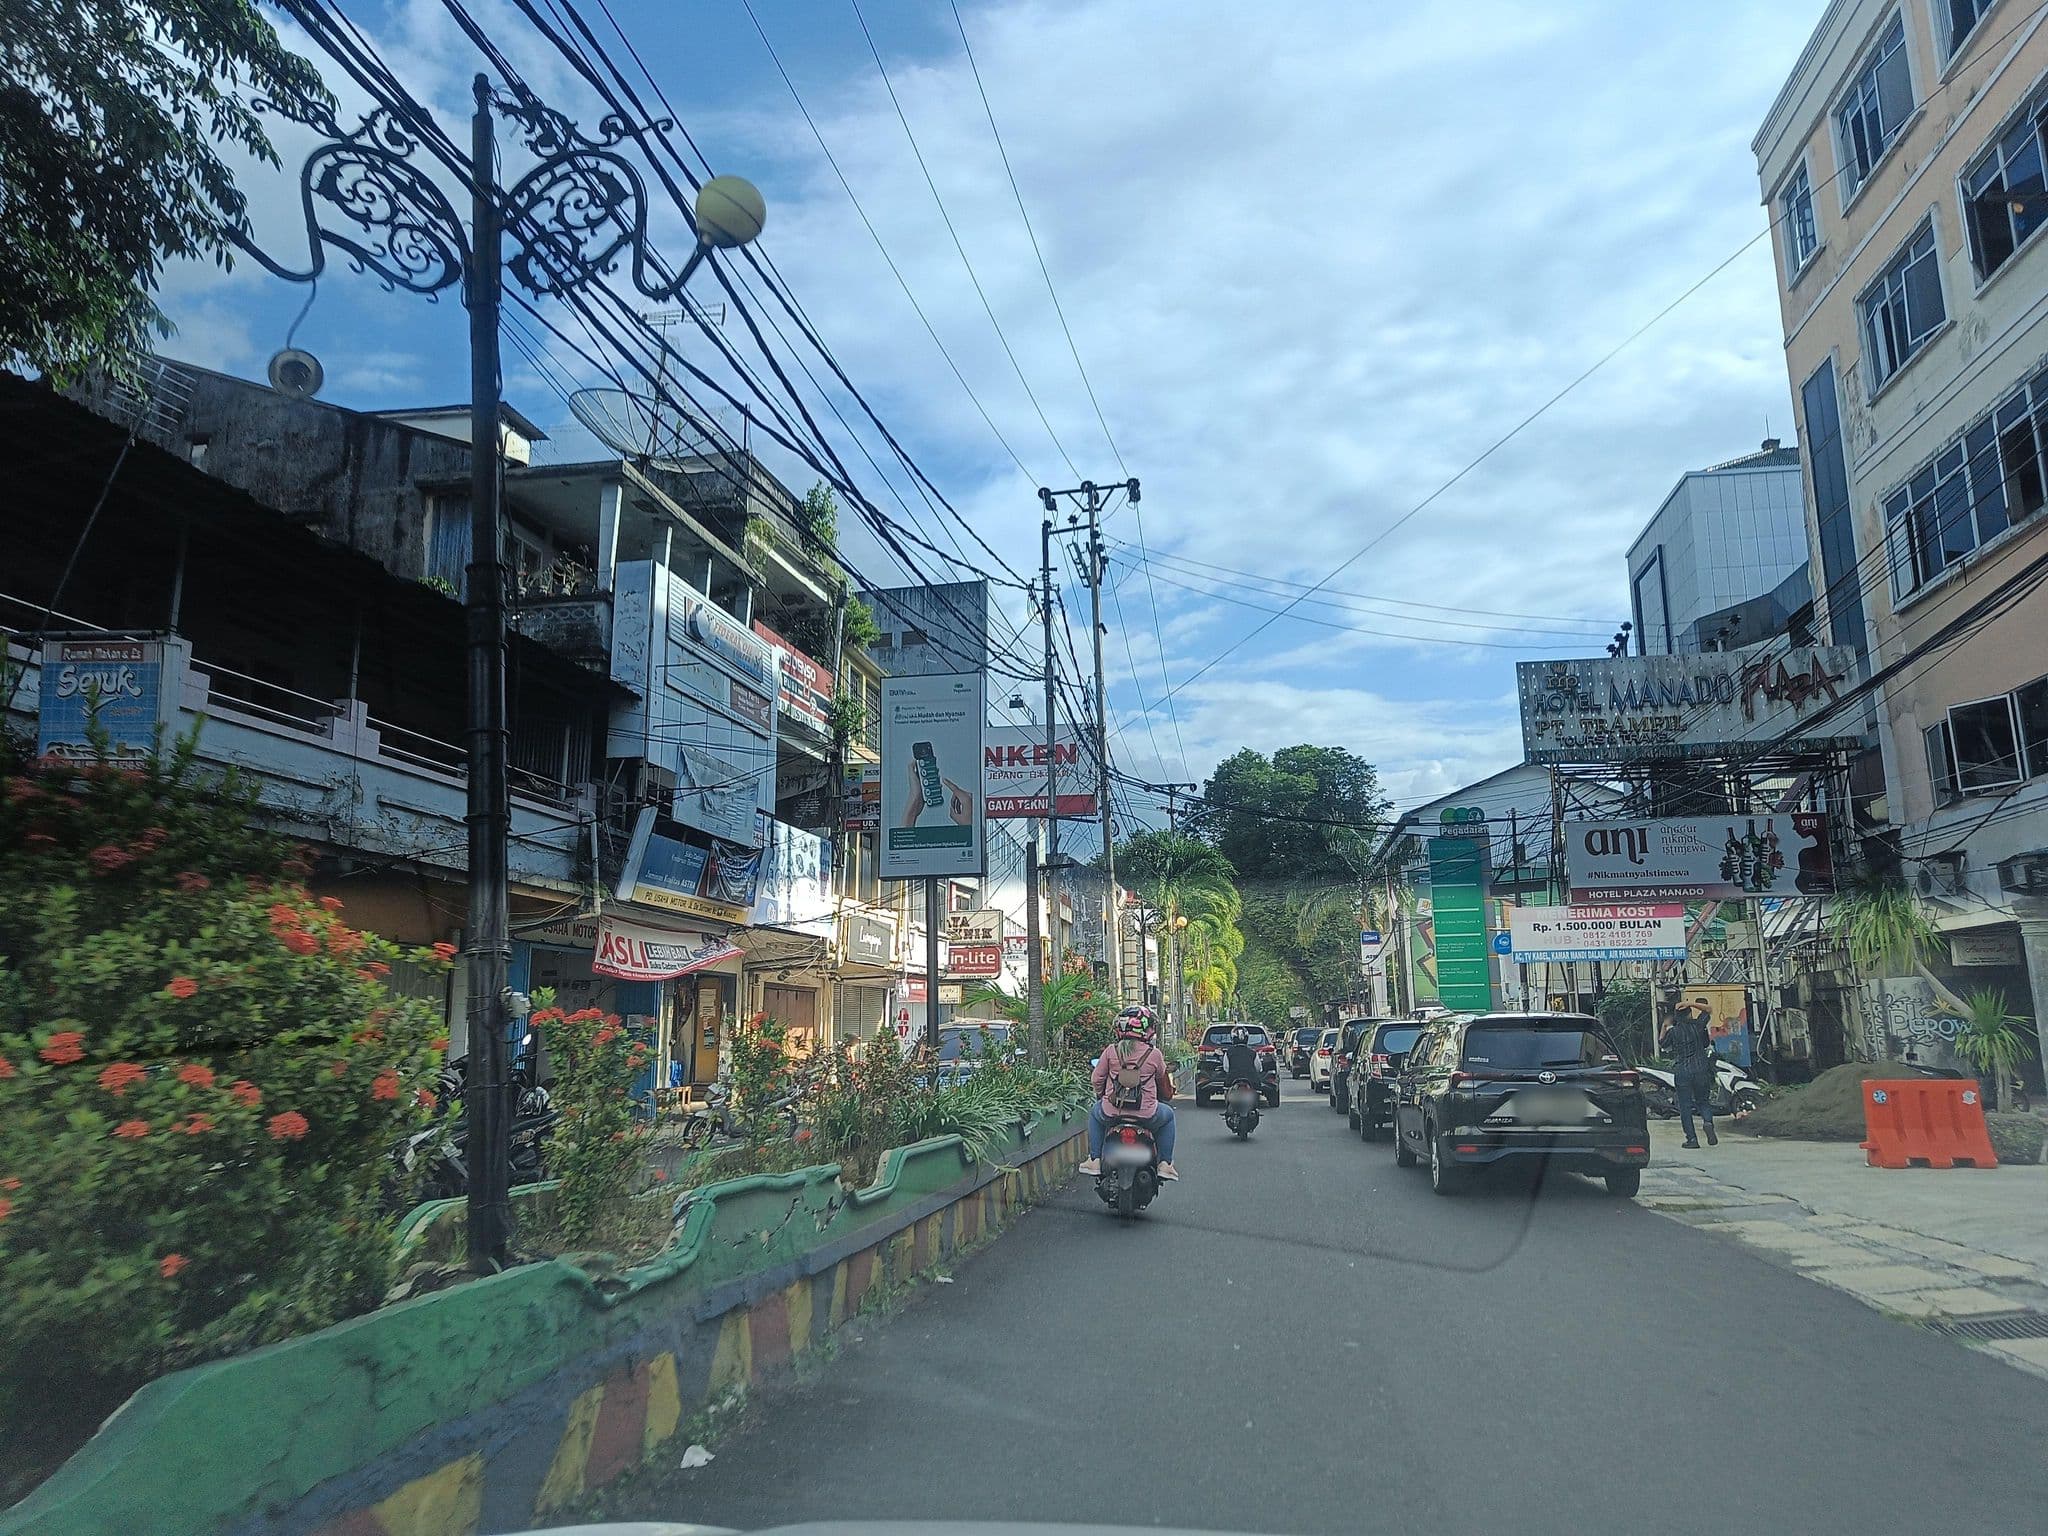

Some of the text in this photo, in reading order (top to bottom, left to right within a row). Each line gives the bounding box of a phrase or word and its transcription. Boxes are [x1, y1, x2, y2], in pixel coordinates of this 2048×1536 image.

[63, 648, 93, 661] Rumah
[791, 655, 816, 683] DENSO
[56, 664, 143, 700] Sejuk
[1535, 691, 1601, 712] HOTEL
[1609, 673, 1733, 714] MANADO
[1536, 719, 1566, 736] PT
[1556, 734, 1605, 747] TOURS
[988, 770, 1023, 780] JEPANG
[988, 800, 1015, 811] GAYA
[1440, 824, 1489, 836] Pegadaian
[1660, 825, 1697, 835] anggur
[1661, 834, 1698, 845] nikmat
[680, 879, 696, 889] ASTRA
[1588, 887, 1705, 899] HOTEL PLAZA MANADO
[669, 897, 687, 908] MOTOR
[1537, 906, 1655, 919] MENERIMA KOST
[1533, 920, 1662, 933] Rp. 1.500.000/ BULAN
[1583, 931, 1605, 939] 0812
[1636, 938, 1648, 946] 22
[600, 931, 649, 969] ASLI
[646, 943, 671, 959] LEBIH
[1524, 952, 1532, 961] TV
[1660, 948, 1674, 957] FREE
